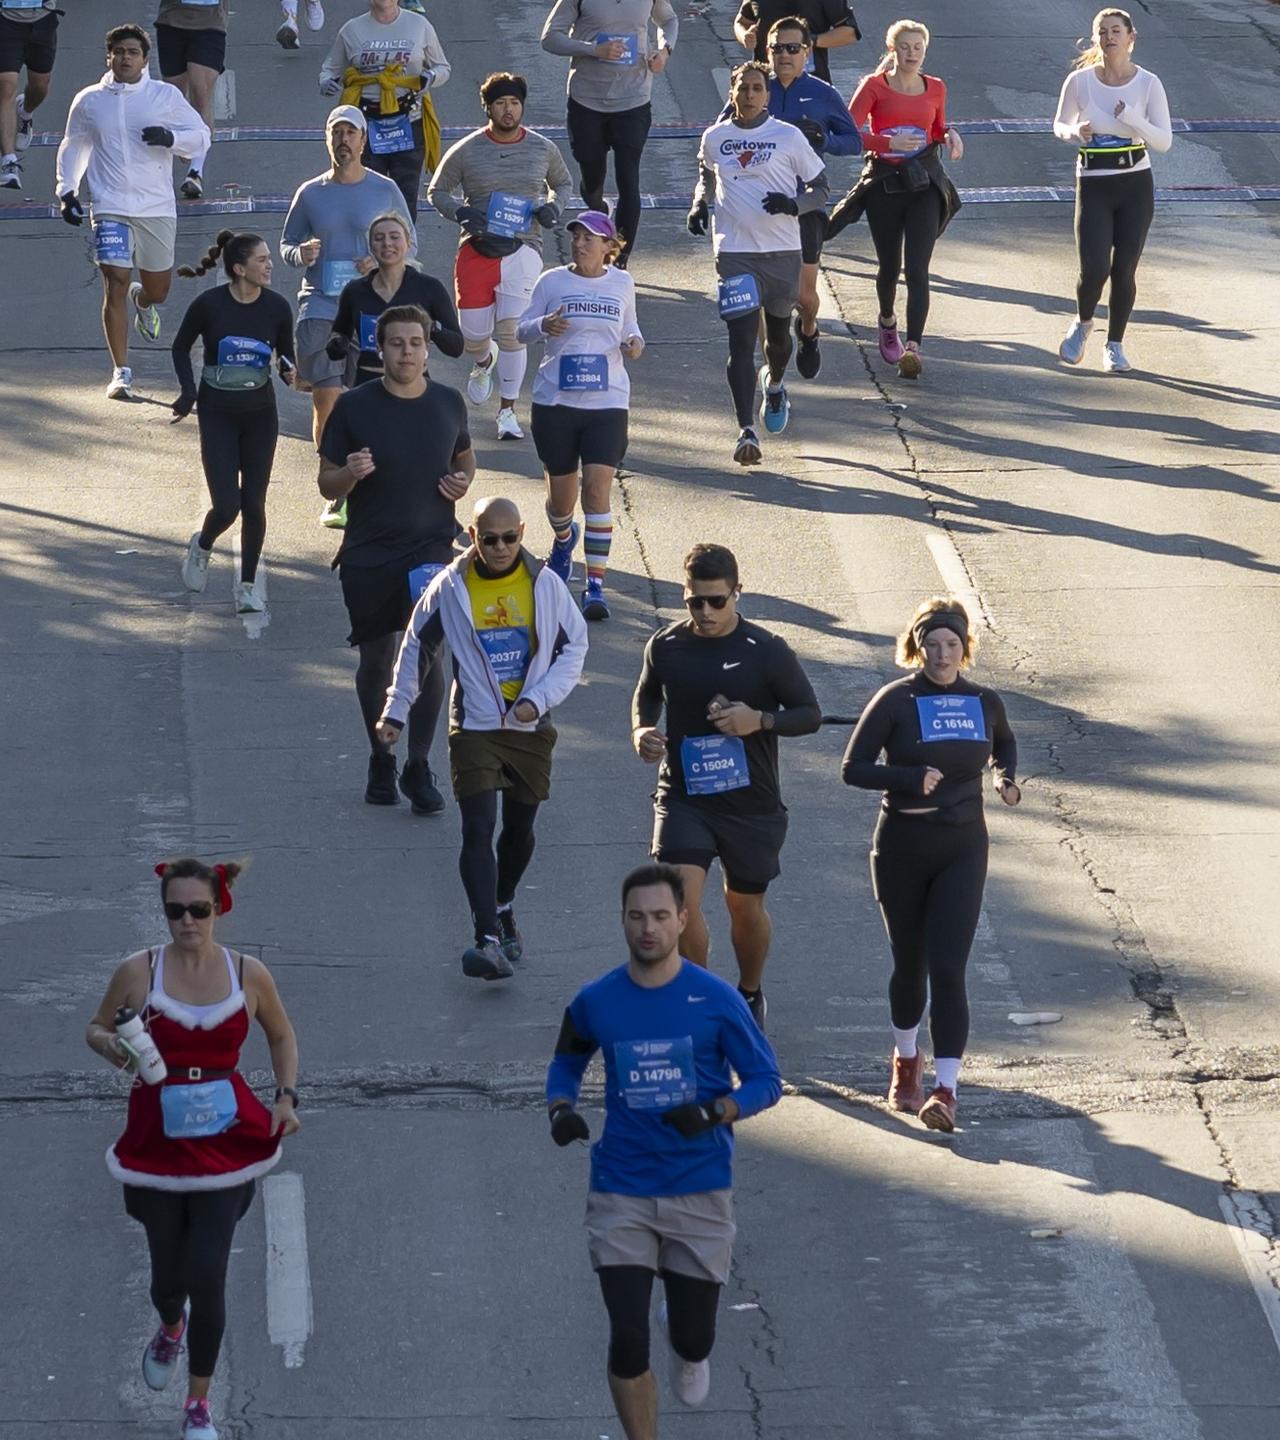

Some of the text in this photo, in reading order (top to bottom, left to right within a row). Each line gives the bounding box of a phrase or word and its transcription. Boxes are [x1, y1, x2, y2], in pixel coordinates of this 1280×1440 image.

[720, 139, 776, 155] Cowtown
[567, 303, 620, 316] FINISHER
[489, 650, 521, 663] 20377
[933, 720, 941, 729] C
[692, 758, 734, 772] C 15024
[630, 1068, 682, 1082] D 14798
